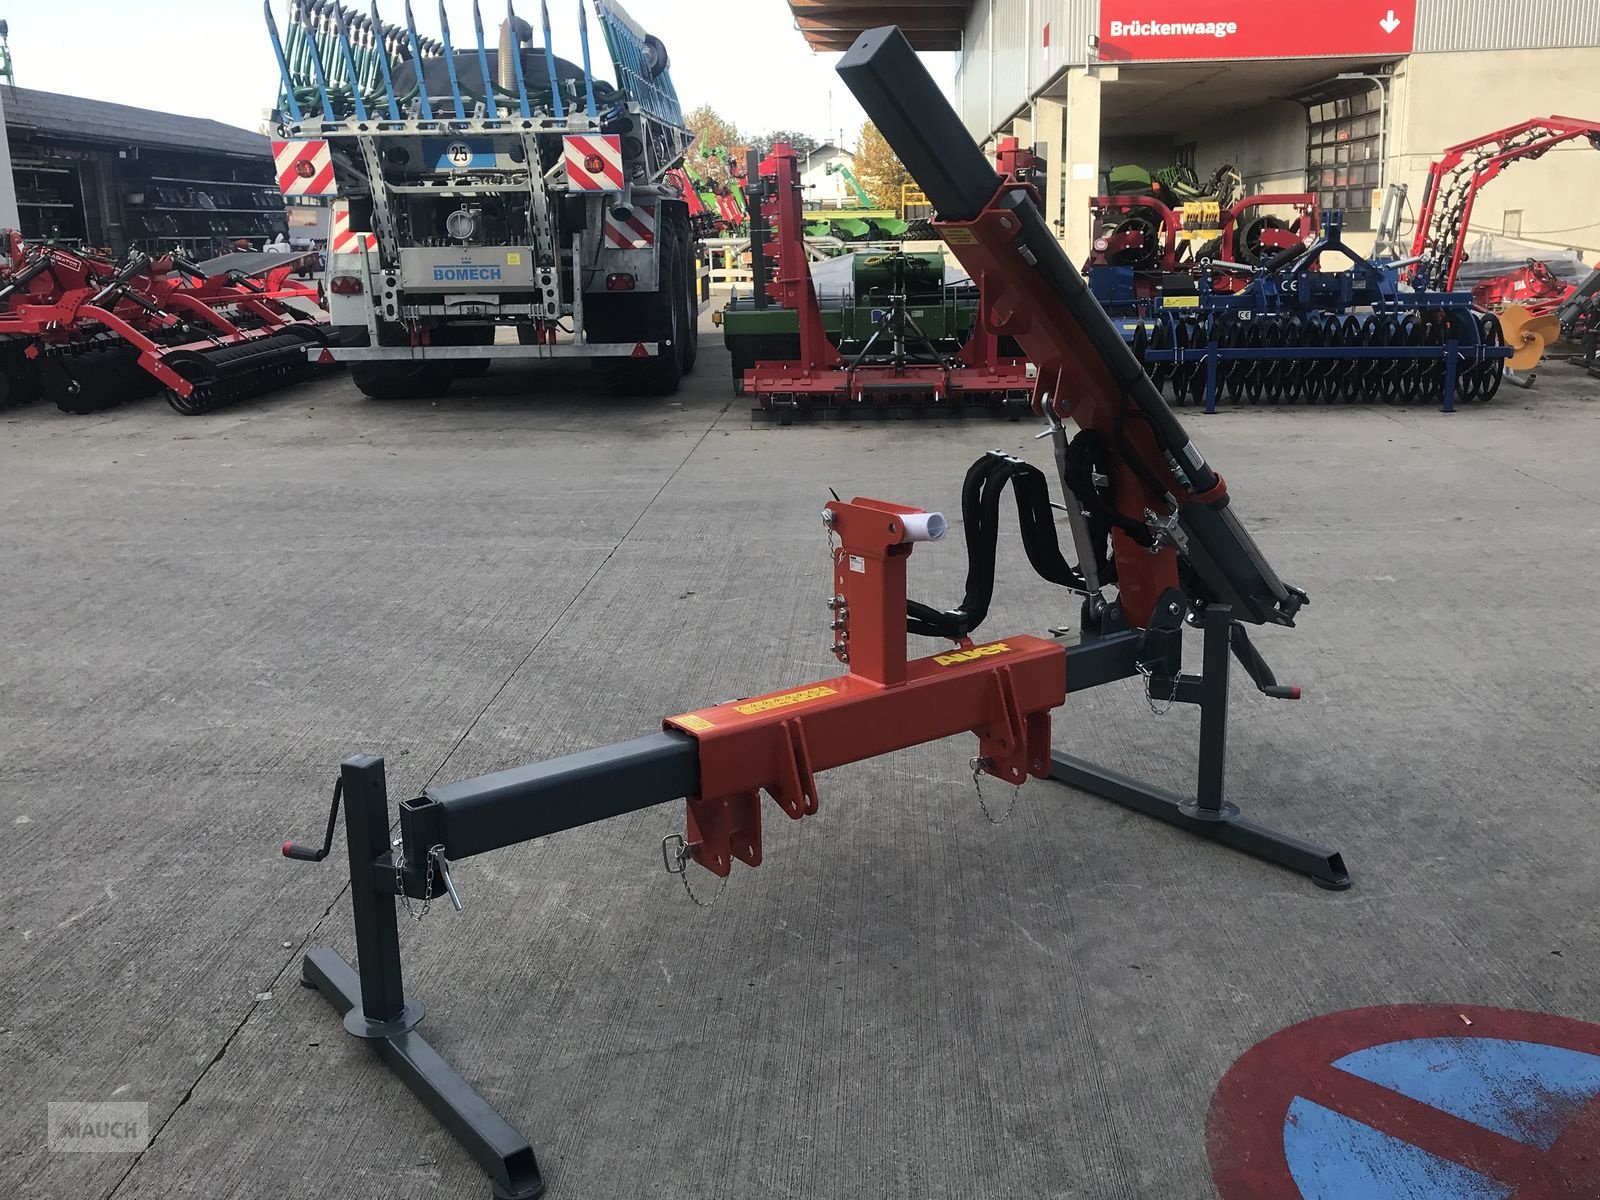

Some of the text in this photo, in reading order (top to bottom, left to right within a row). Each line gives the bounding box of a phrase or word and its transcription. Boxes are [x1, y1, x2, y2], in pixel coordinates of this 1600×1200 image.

[1110, 20, 1237, 38] Brückenwaage
[451, 146, 468, 162] 25
[433, 268, 502, 281] BOMECH
[1281, 280, 1298, 291] CE
